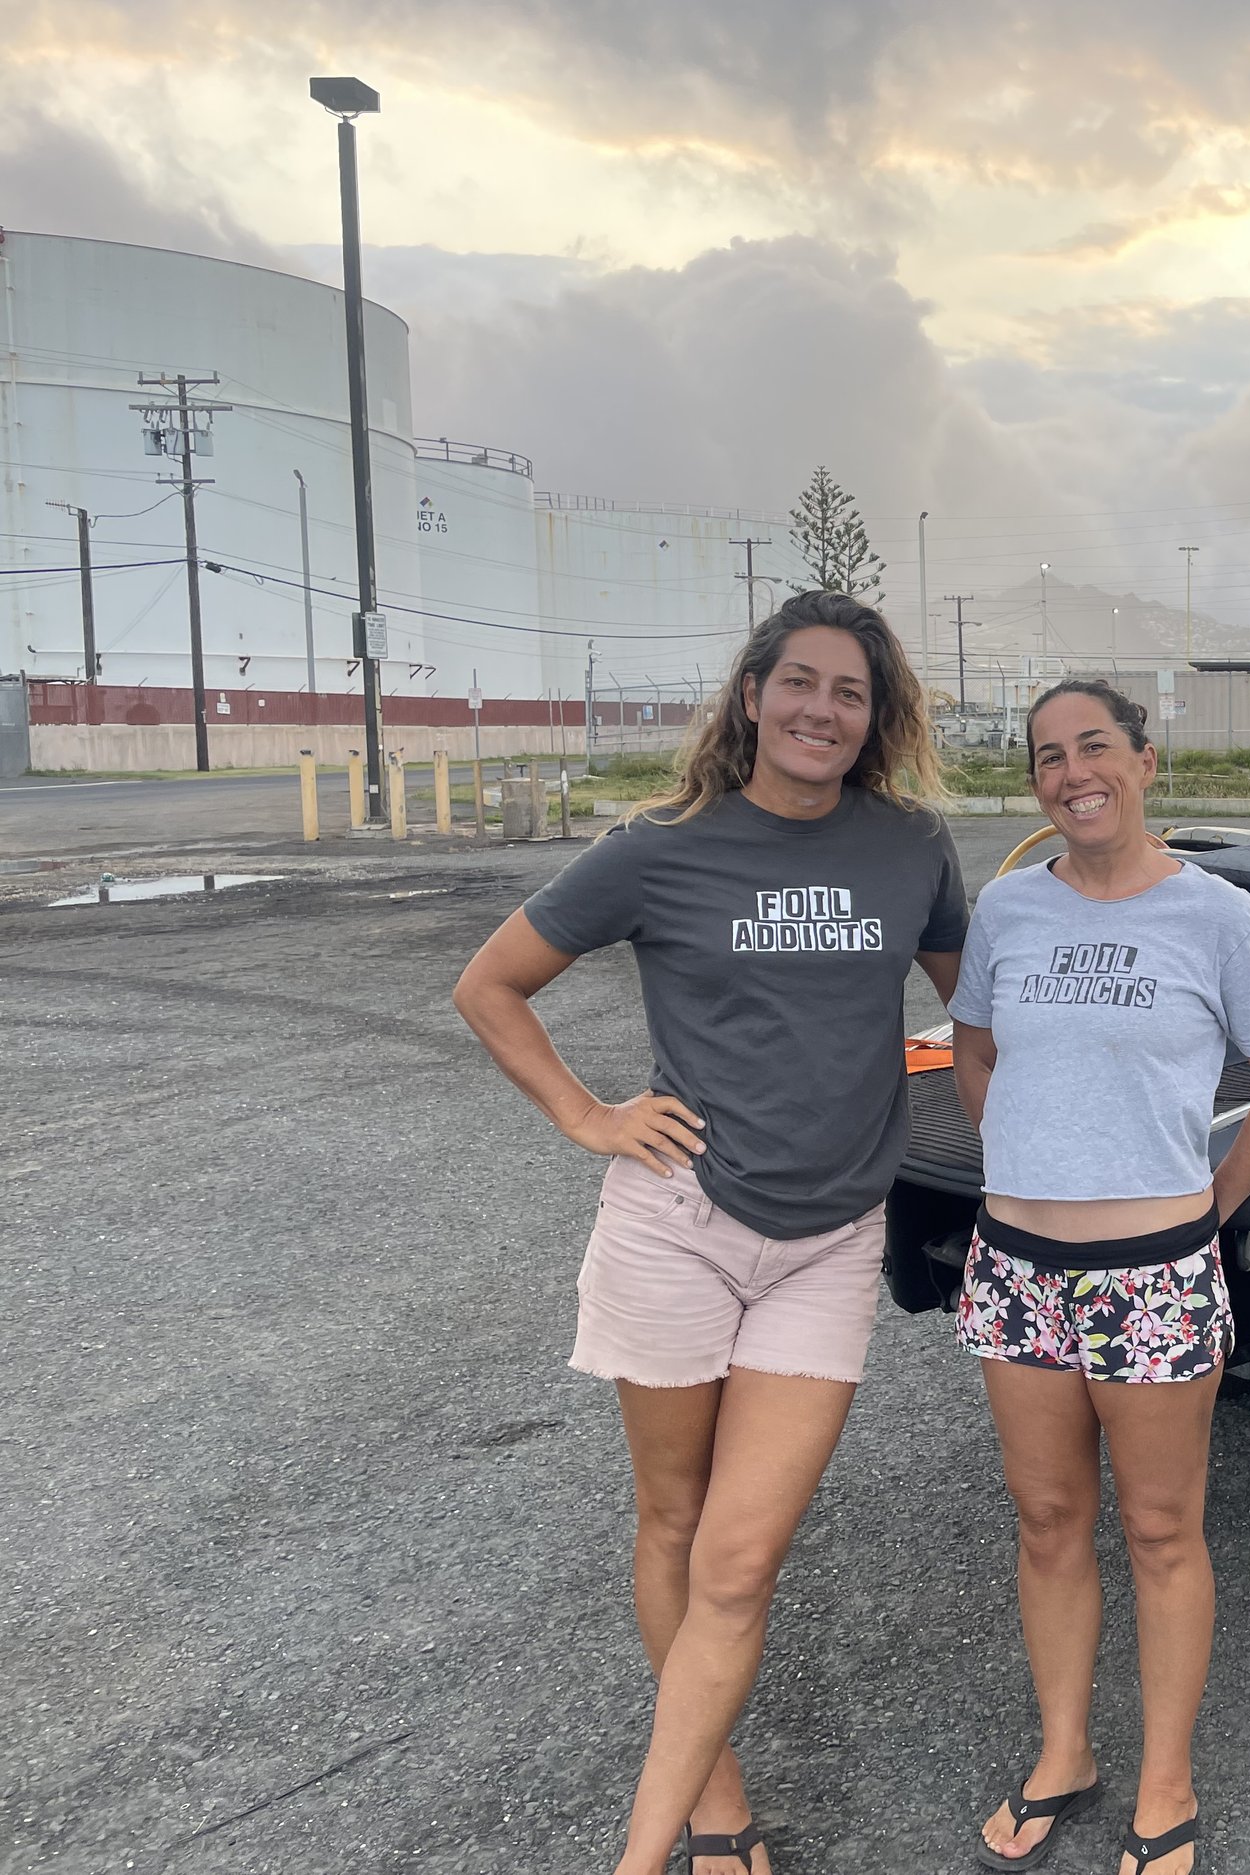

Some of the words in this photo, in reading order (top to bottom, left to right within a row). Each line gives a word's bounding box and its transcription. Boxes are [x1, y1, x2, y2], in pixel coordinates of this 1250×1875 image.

[435, 523, 448, 533] 15
[438, 513, 446, 522] A
[757, 887, 851, 921] FOIL
[732, 919, 882, 951] ADDICTS
[1050, 943, 1138, 974] FOIL
[1019, 975, 1157, 1009] ADDICTS
